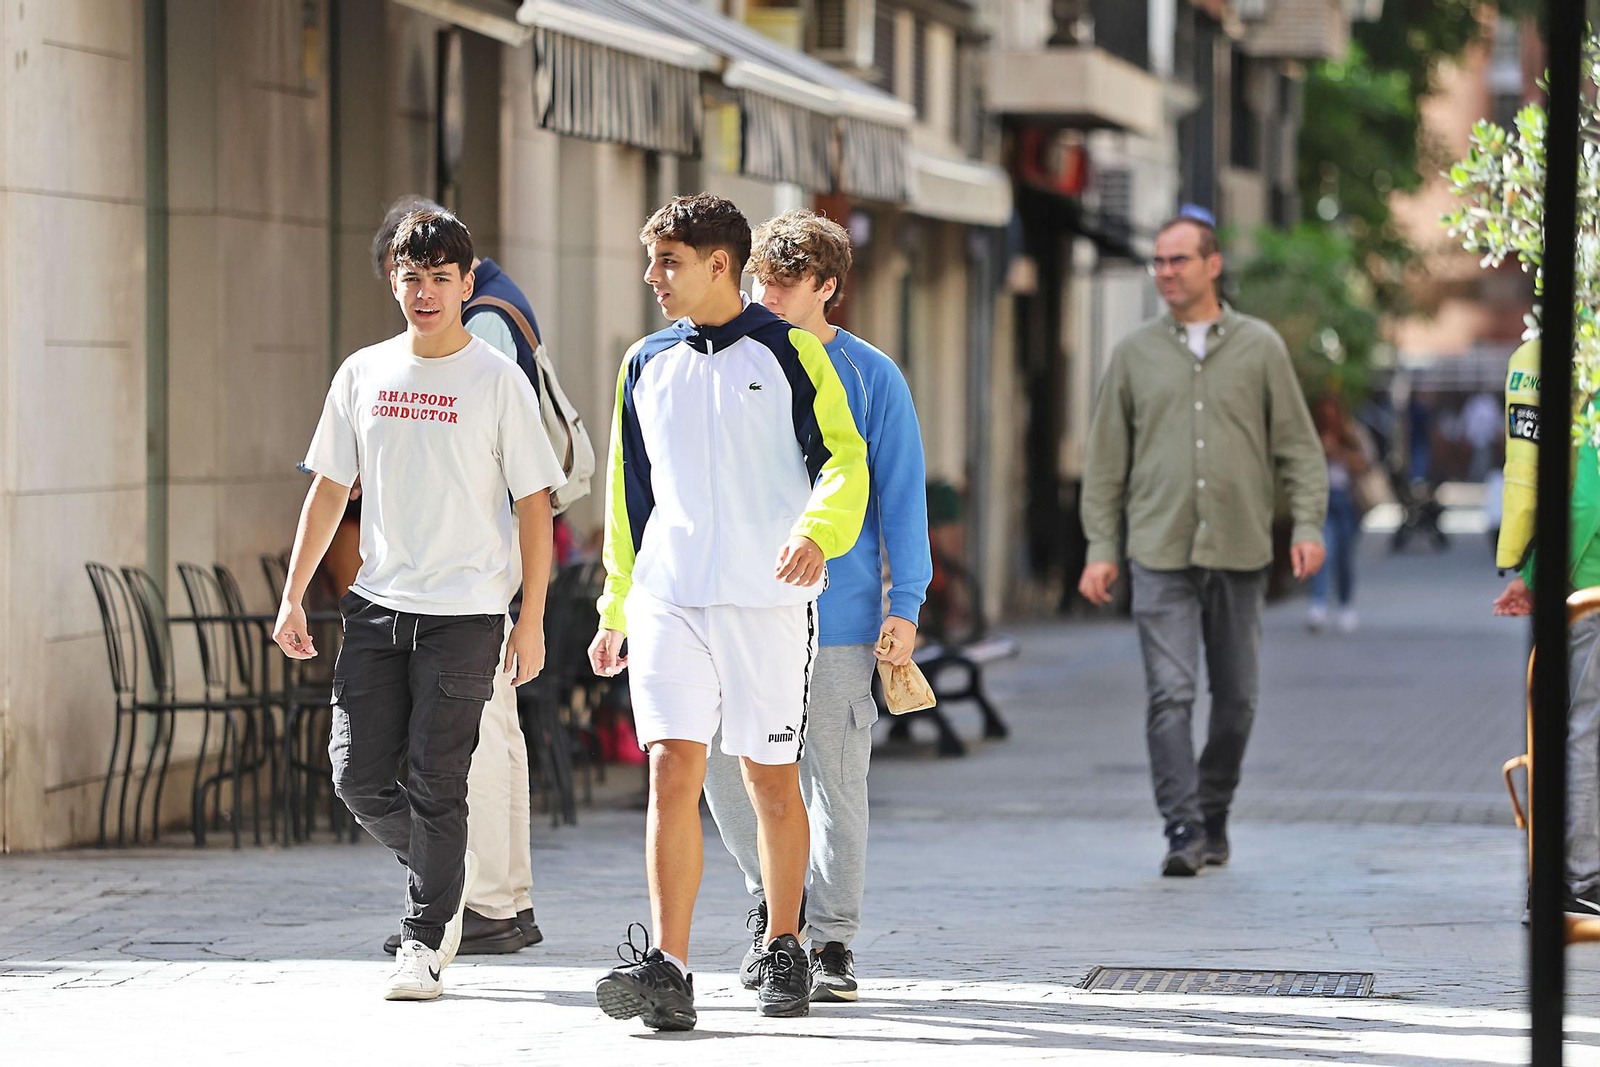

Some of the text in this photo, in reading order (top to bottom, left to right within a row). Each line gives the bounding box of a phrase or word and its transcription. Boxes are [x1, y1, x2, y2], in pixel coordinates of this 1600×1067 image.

[378, 390, 457, 407] RHAPSODY
[371, 405, 458, 423] CONDUCTOR
[768, 733, 793, 743] PUMA
